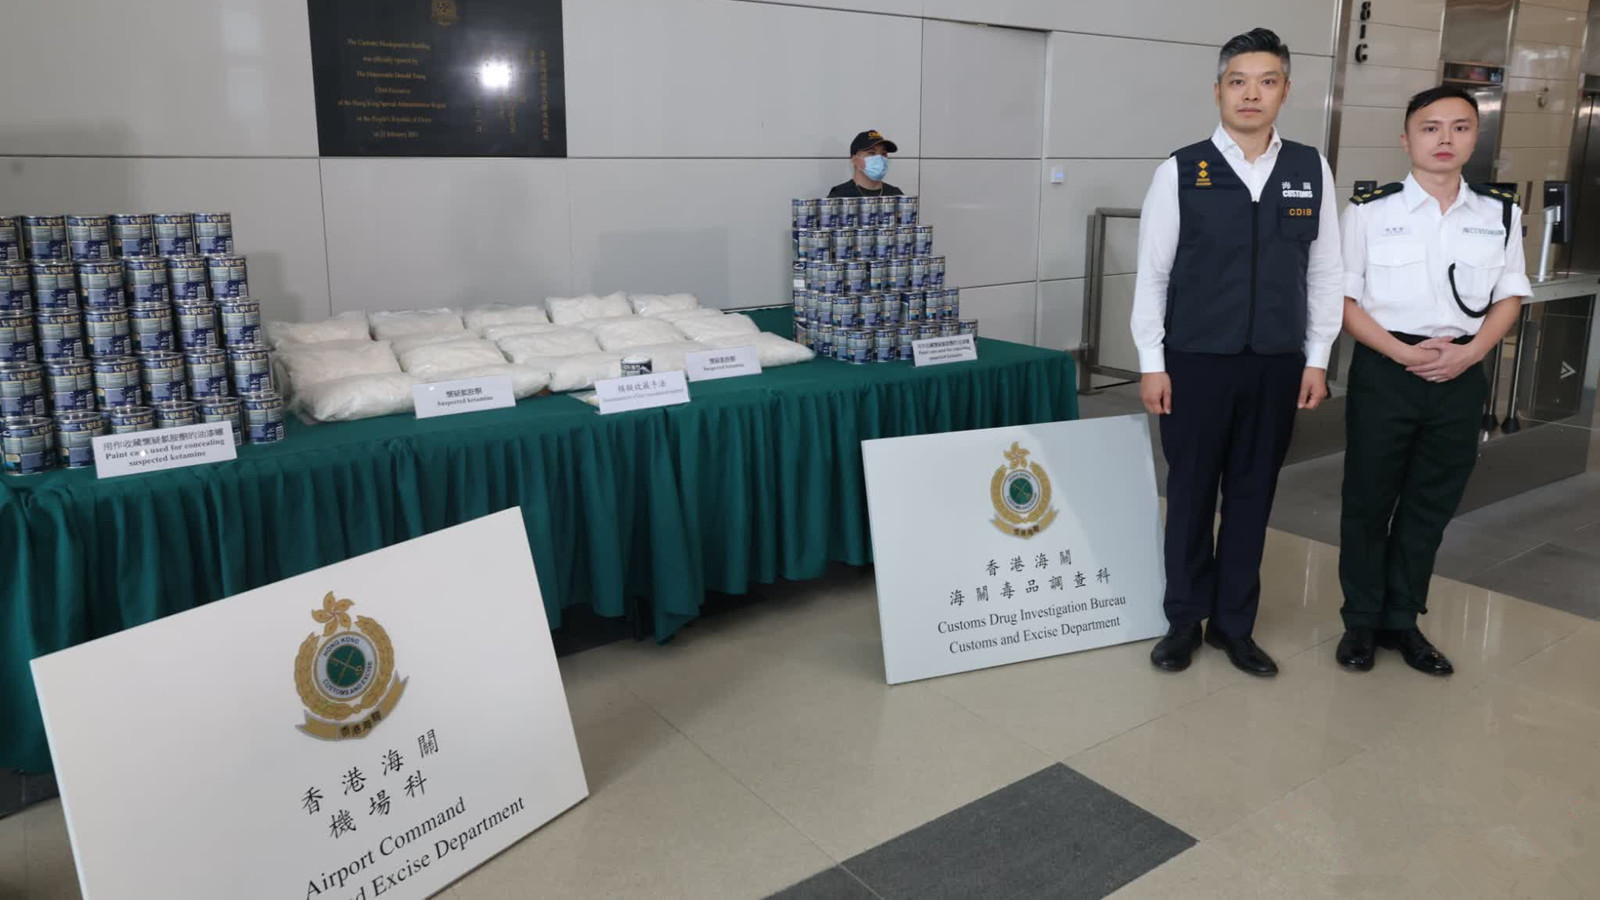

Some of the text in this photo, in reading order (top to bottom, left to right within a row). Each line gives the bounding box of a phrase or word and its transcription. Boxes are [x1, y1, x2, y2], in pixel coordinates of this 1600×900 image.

[1282, 190, 1313, 198] CUSTOMS
[105, 451, 127, 460] Paint
[130, 449, 149, 458] cas
[150, 446, 169, 454] used
[184, 439, 225, 450] concealing
[128, 450, 206, 467] suspected ketamine
[986, 550, 1072, 577] 香港海關
[949, 567, 1111, 606] 海關毒品調查科
[938, 595, 1126, 634] Customs Drug Investigation Bureau
[324, 640, 340, 657] HONG
[950, 616, 1121, 654] Customs and Excise Department
[322, 661, 373, 696] CUSTOMS AND EXCISE
[302, 728, 439, 815] 香港海關
[329, 770, 427, 839] 機場科
[306, 796, 466, 900] Airport Command
[371, 797, 525, 897] Excise Department
